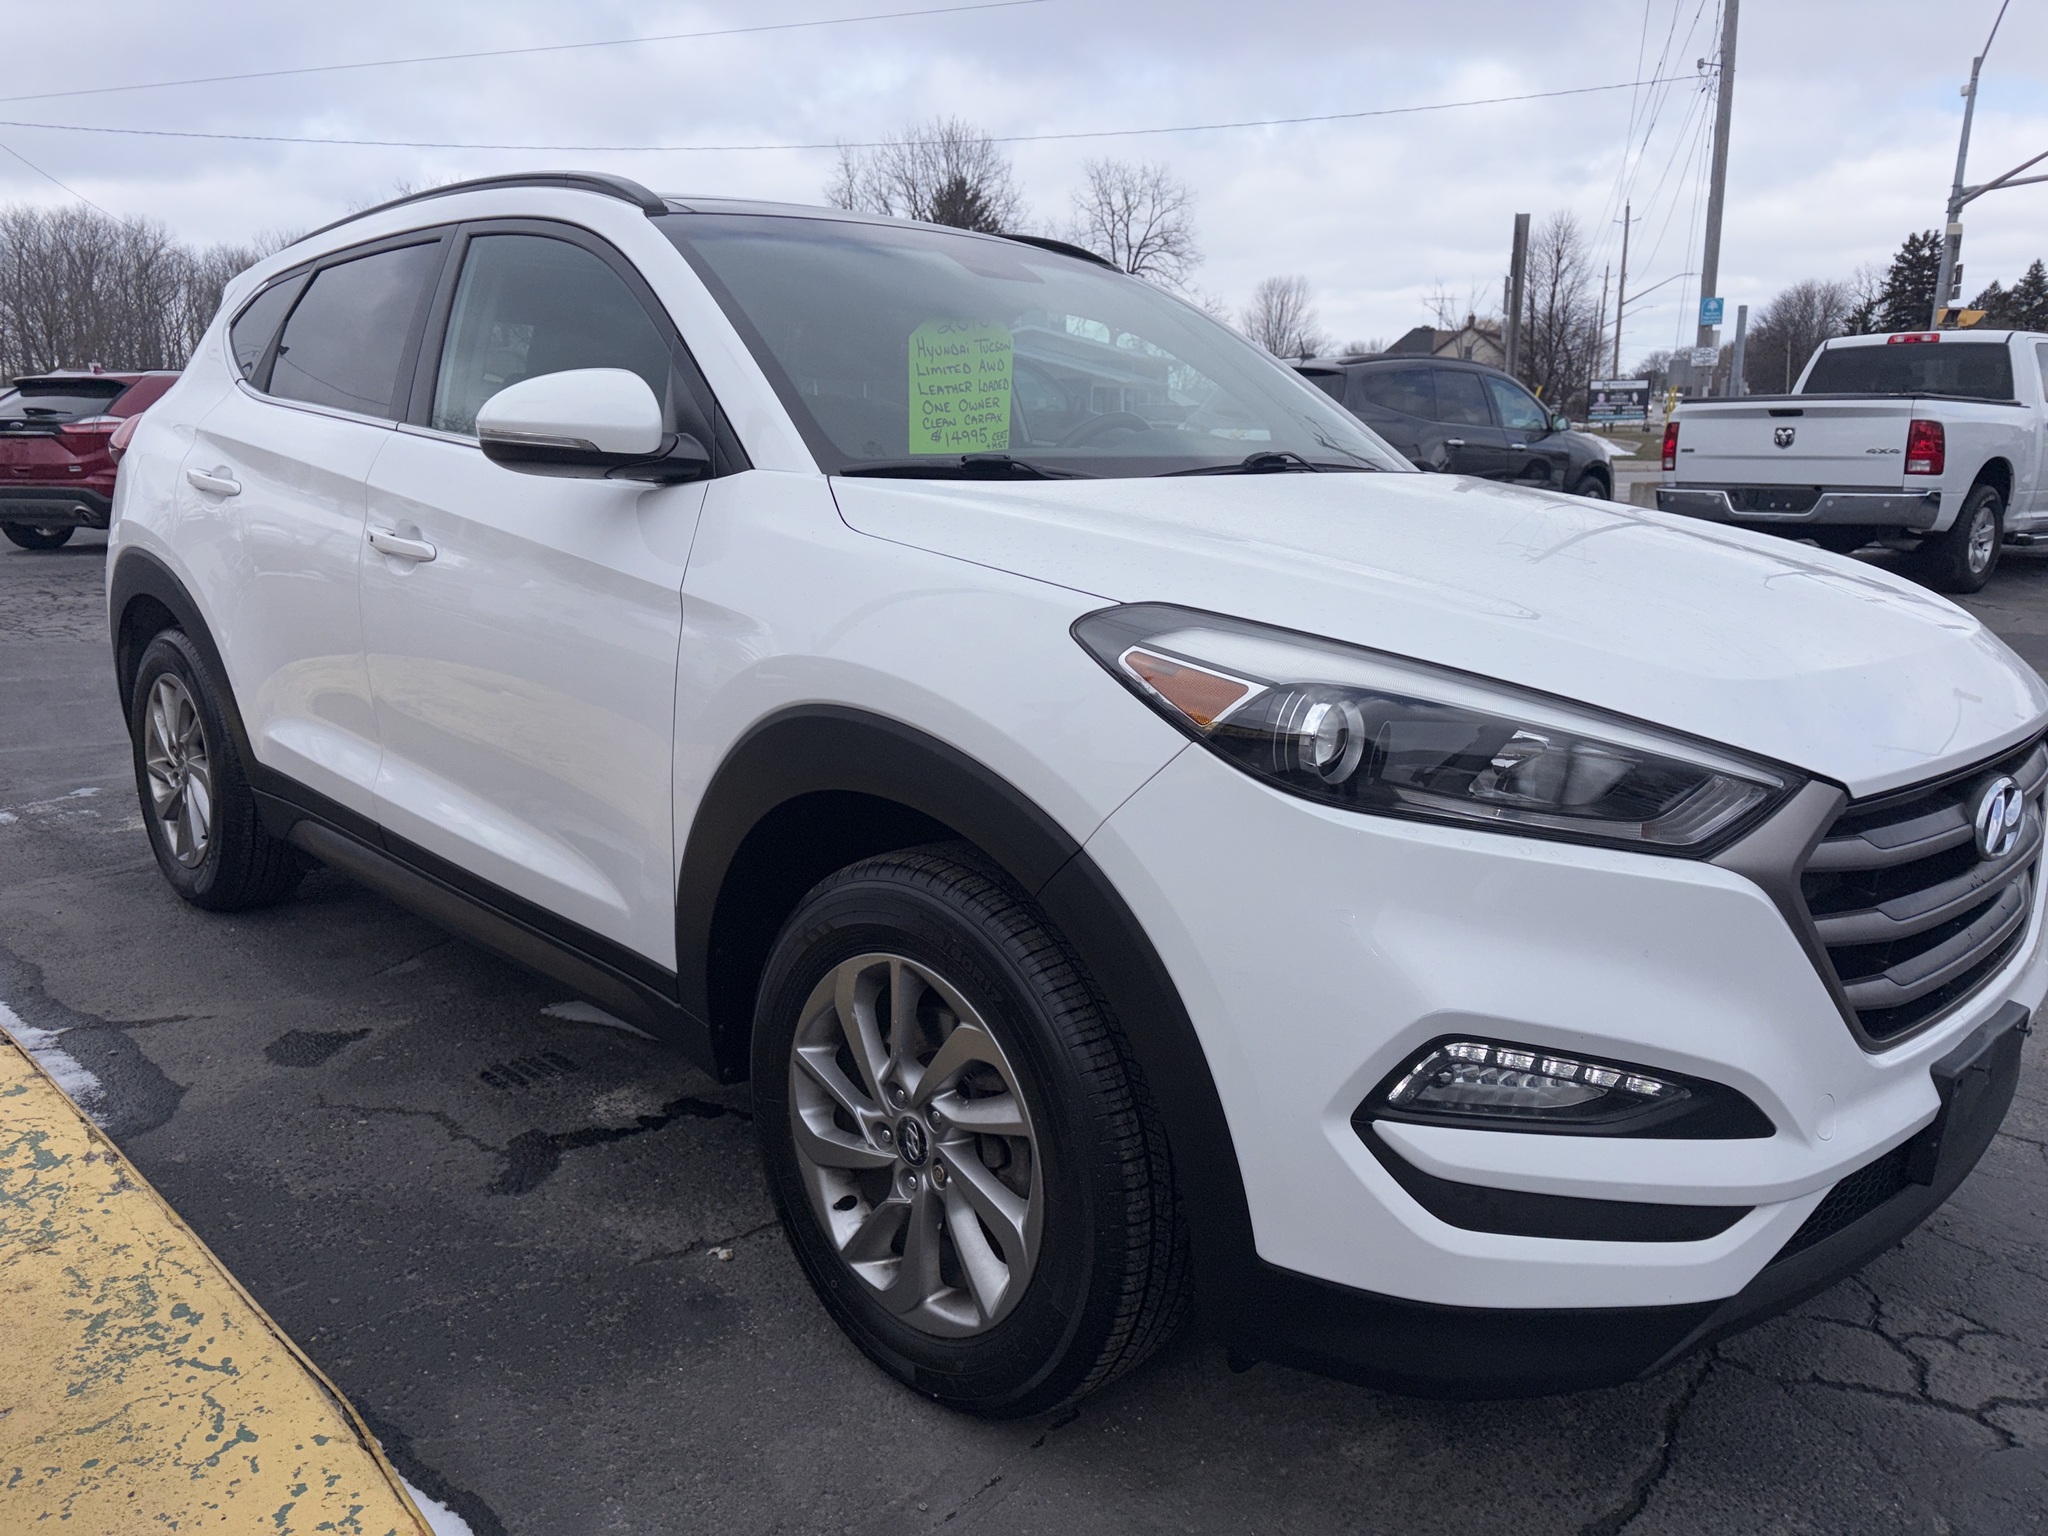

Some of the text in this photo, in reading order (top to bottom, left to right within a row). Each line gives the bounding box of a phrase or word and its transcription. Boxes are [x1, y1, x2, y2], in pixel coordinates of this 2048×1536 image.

[973, 337, 1011, 354] TUCSON
[915, 358, 1005, 377] LIMITED AWD
[917, 377, 1010, 396] LEATHER LOADED
[922, 396, 1000, 415] ONE OWNER
[922, 412, 1003, 430] CLEAN CARFAX
